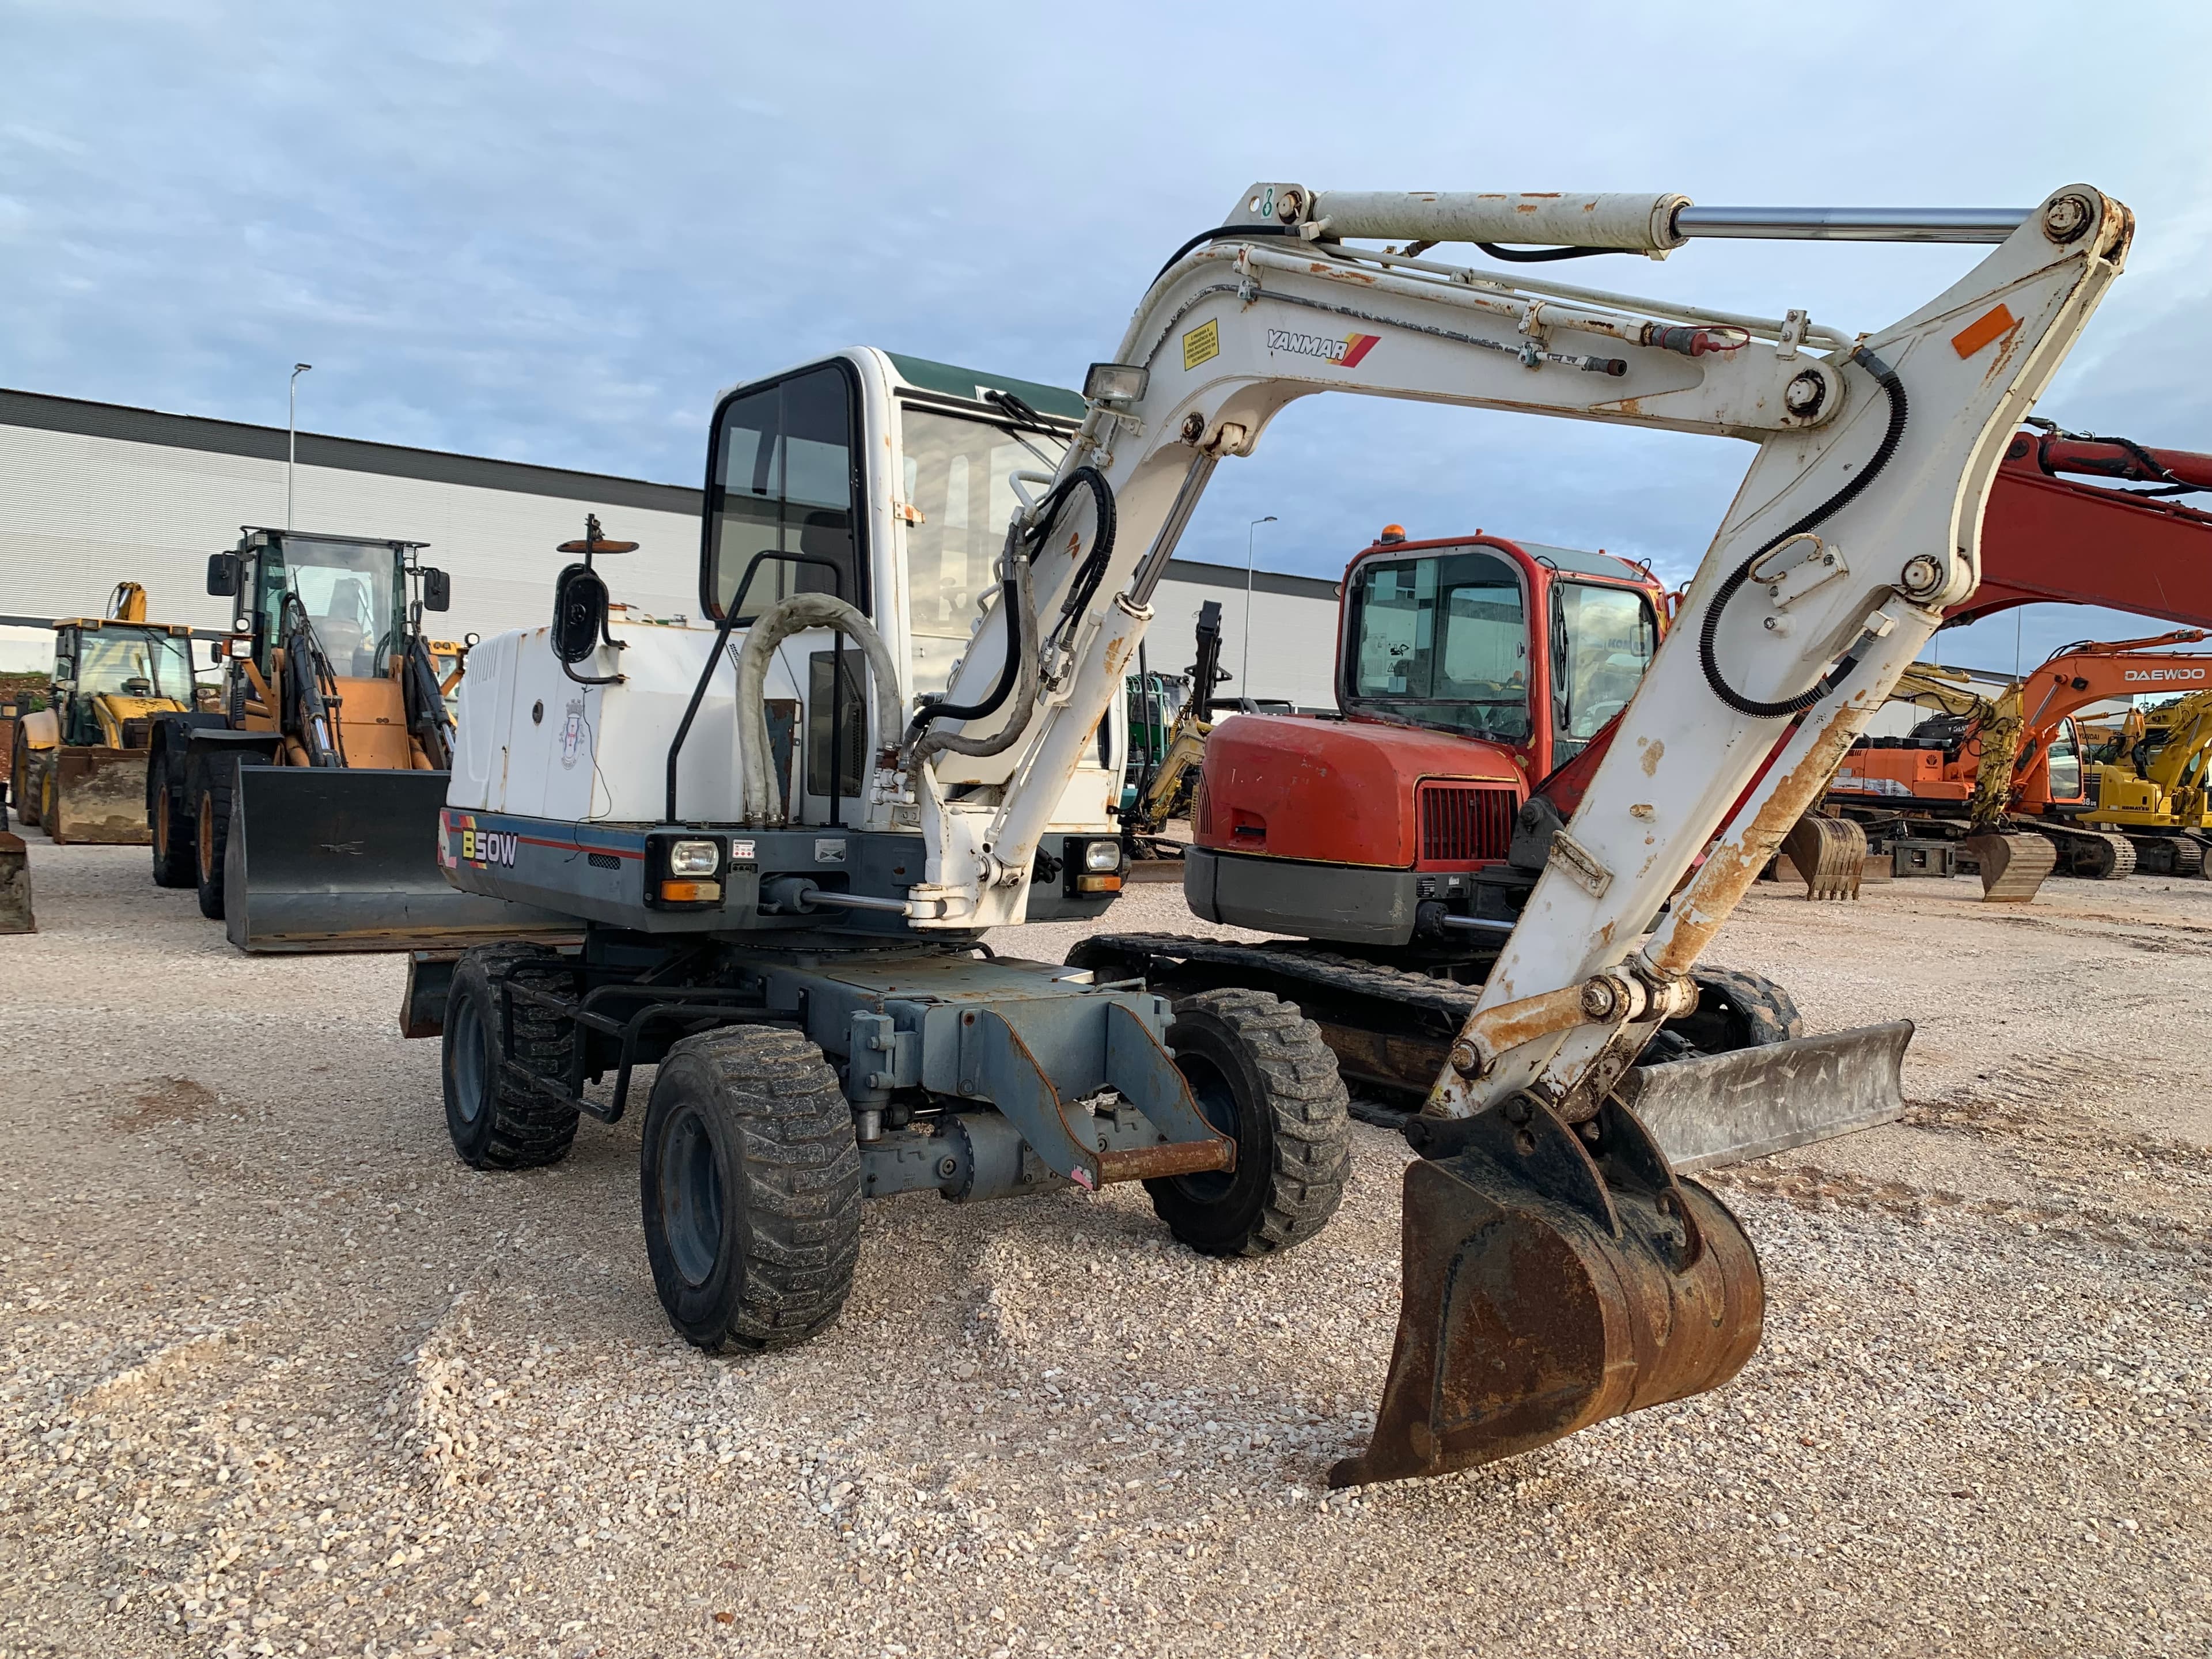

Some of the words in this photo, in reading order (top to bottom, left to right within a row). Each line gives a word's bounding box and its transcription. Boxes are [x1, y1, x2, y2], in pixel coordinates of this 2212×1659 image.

[1267, 329, 1349, 361] YANMAR
[2124, 668, 2206, 681] DAEWOO
[462, 828, 518, 868] B50W
